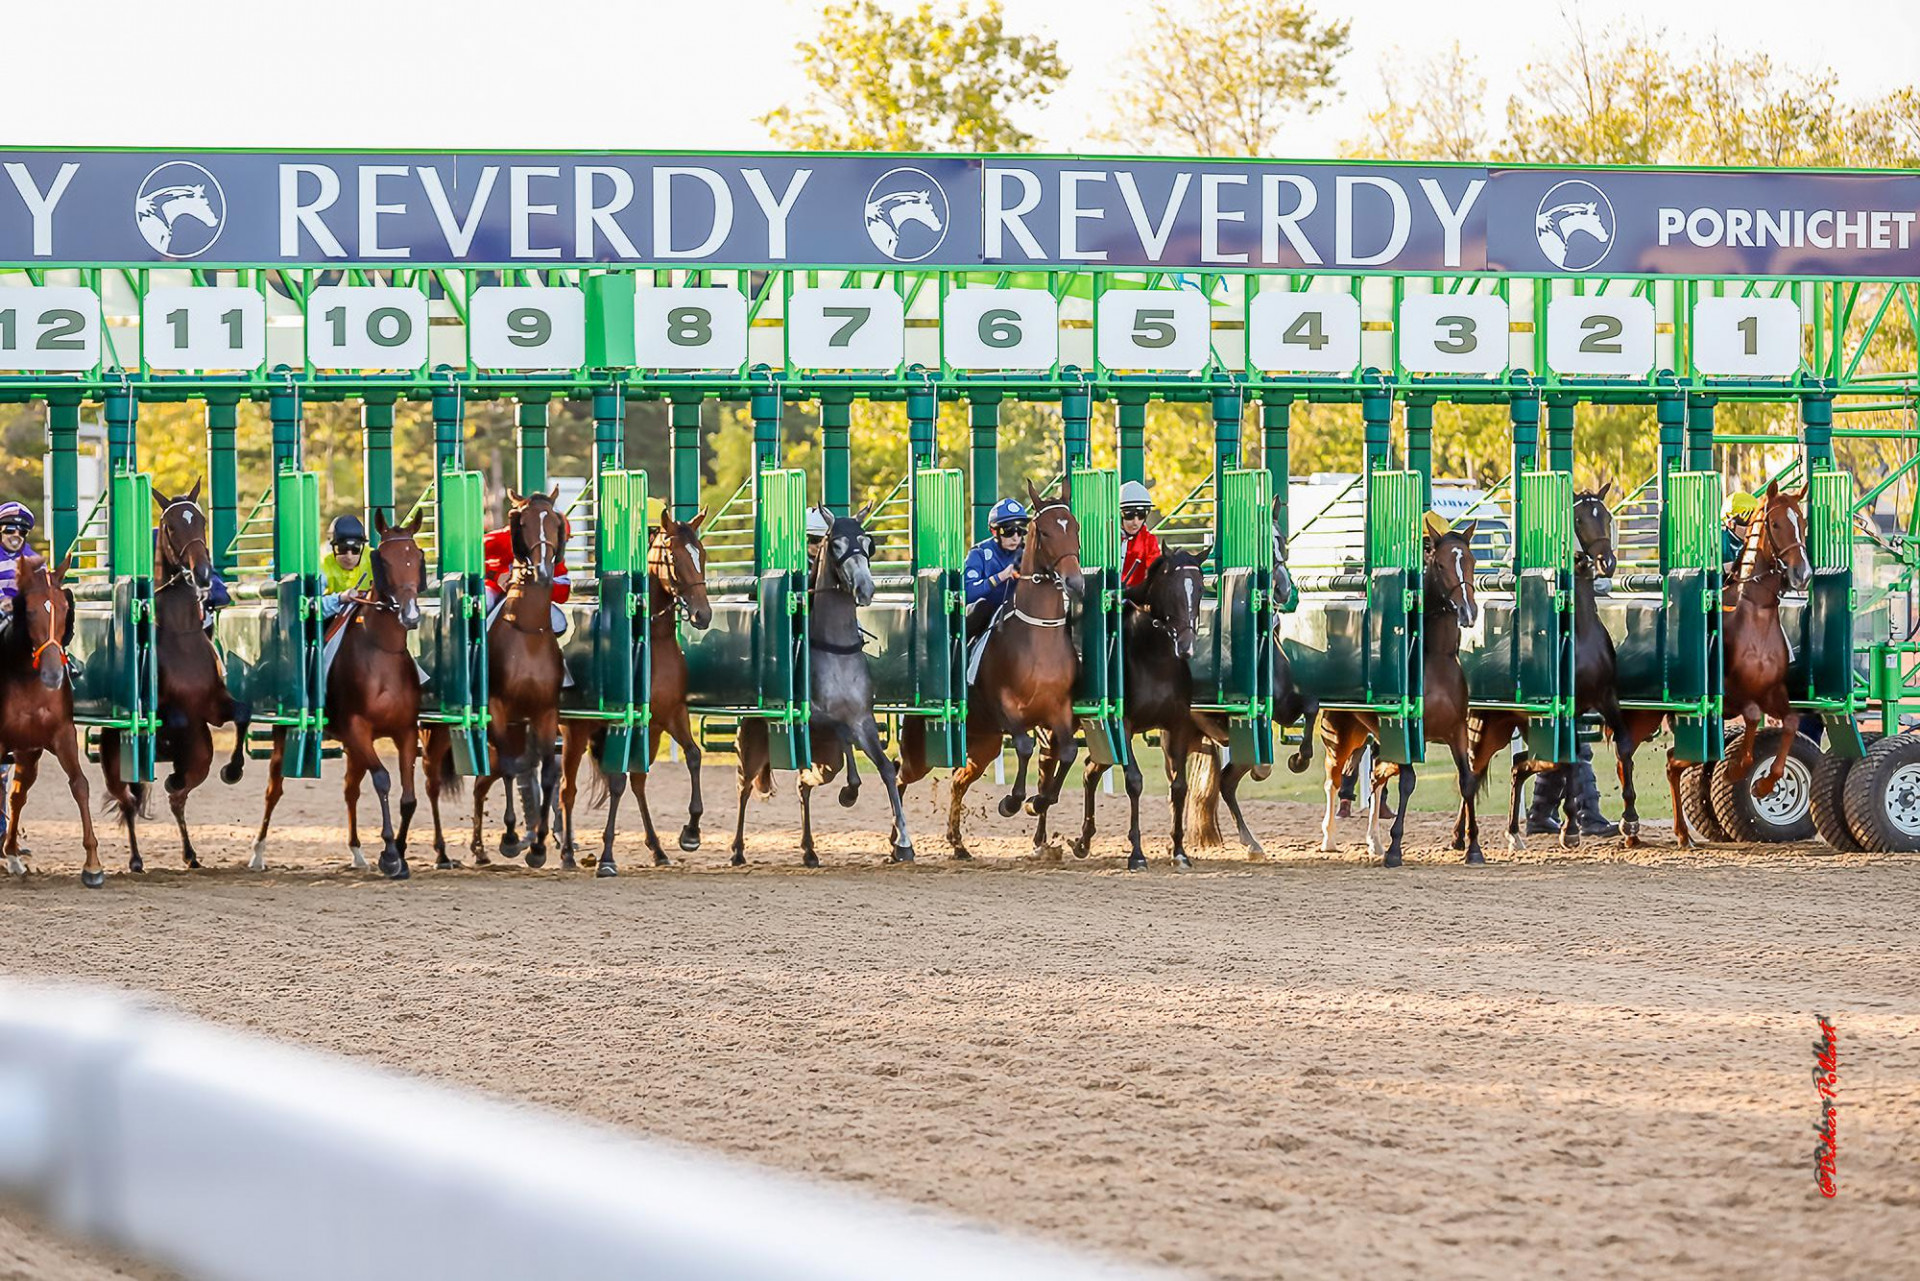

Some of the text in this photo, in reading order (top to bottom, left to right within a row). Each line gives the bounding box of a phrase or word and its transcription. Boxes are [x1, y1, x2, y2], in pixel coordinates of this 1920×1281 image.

[279, 164, 813, 259] REVERDY
[984, 168, 1488, 267] REVERDY
[1658, 207, 1916, 249] PORNICHET
[0, 308, 86, 351] 12
[166, 307, 243, 350] 11
[324, 306, 413, 348] 10
[506, 307, 552, 348] 9
[666, 306, 713, 347] 8
[822, 305, 872, 347] 7
[977, 308, 1023, 349] 6
[1130, 308, 1177, 349] 5
[1282, 311, 1329, 351] 4
[1433, 315, 1478, 355] 3
[1578, 314, 1623, 354] 2
[1737, 316, 1758, 356] 1
